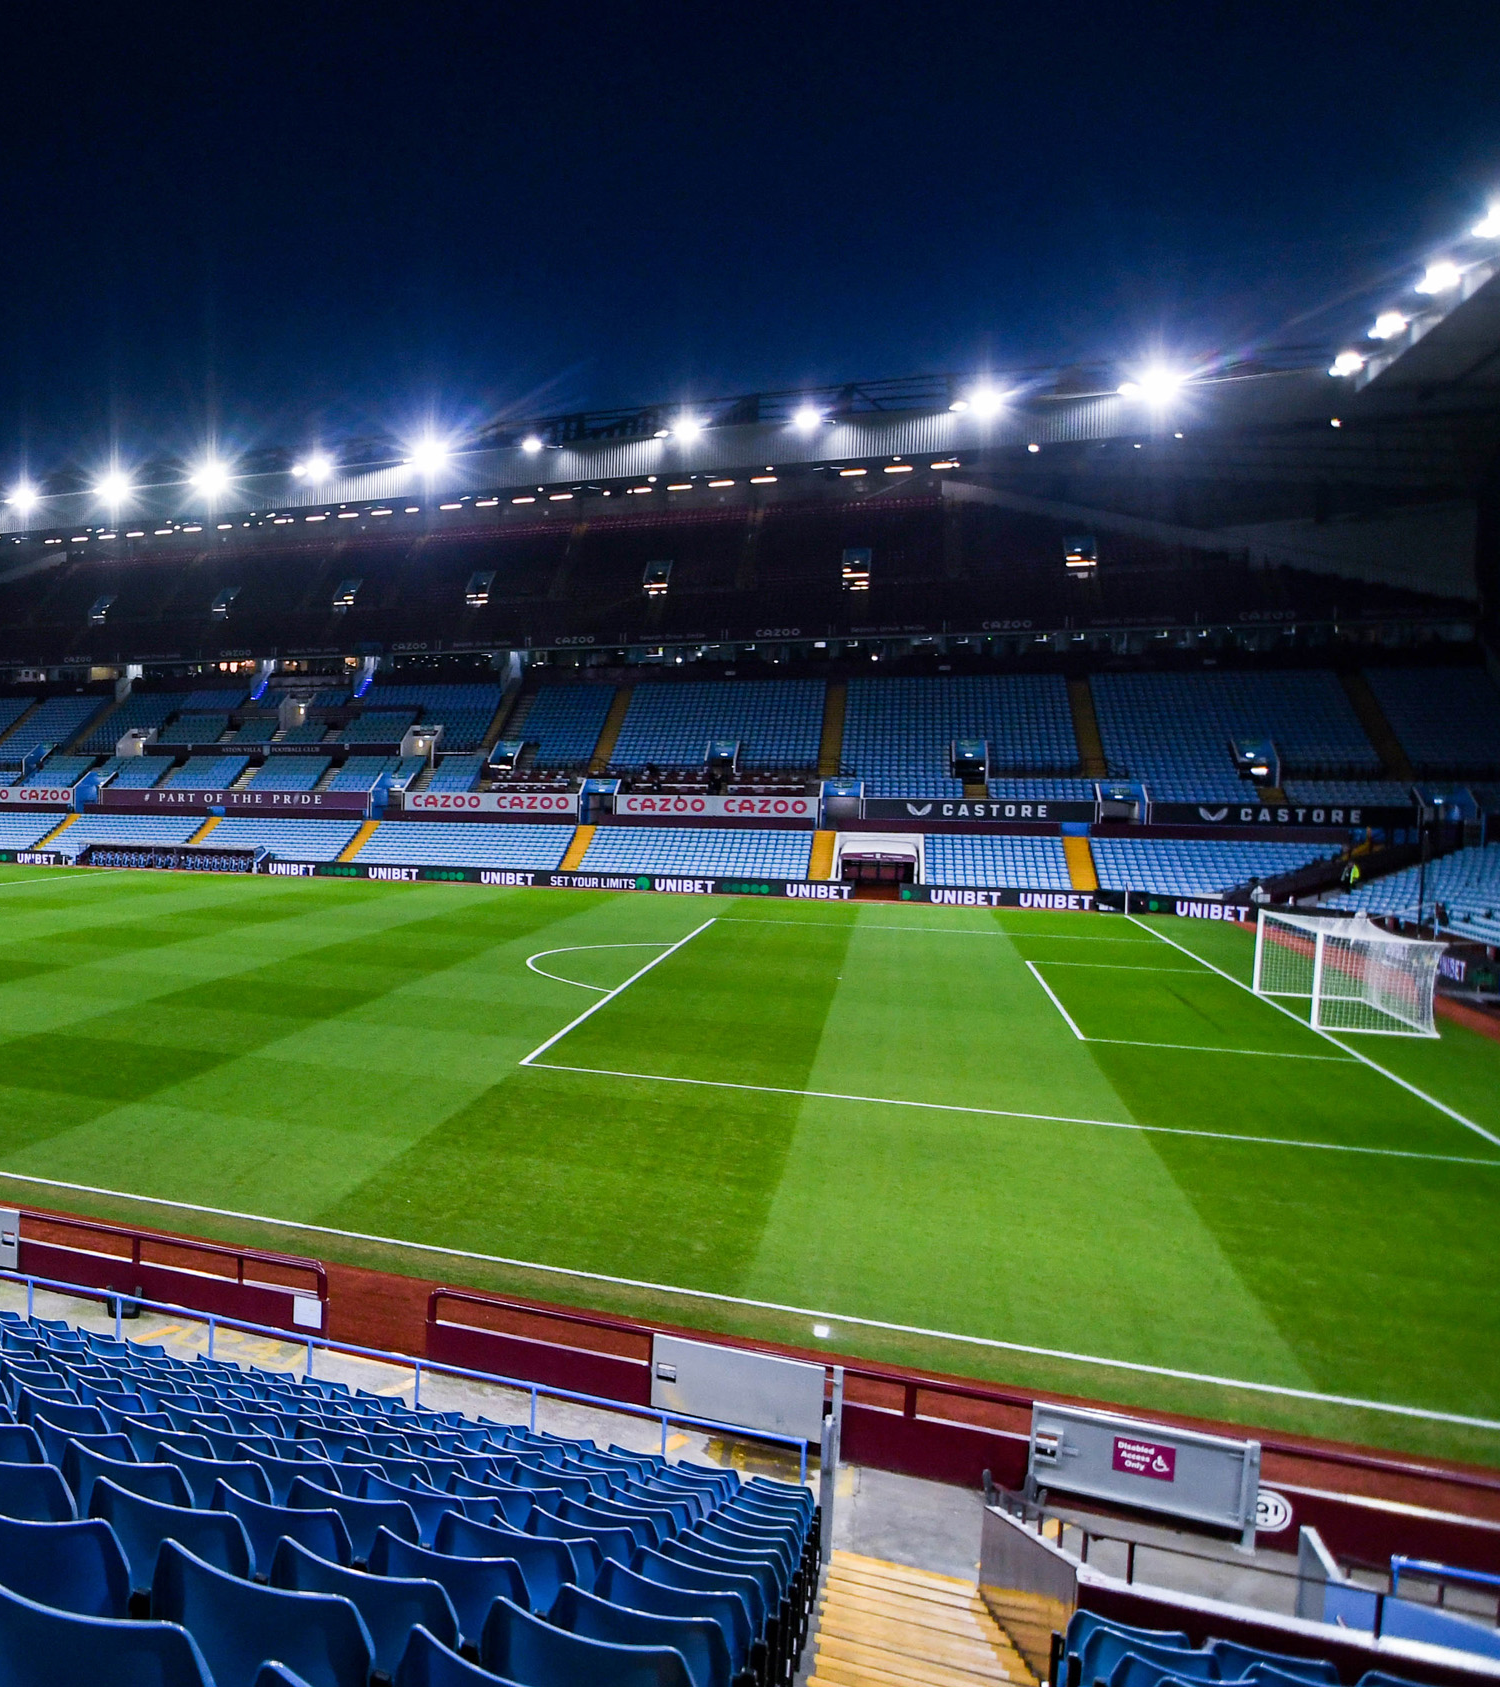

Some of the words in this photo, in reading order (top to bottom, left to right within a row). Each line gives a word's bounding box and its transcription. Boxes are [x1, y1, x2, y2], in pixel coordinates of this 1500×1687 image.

[981, 620, 1033, 630] CAZOO
[555, 635, 595, 645] CAZOO
[755, 628, 801, 638] CAZOO
[220, 649, 252, 657] CAZOO
[391, 642, 428, 651] CAZOO
[63, 656, 92, 664] CAZOO
[19, 789, 71, 801] CAZOO
[158, 793, 195, 803] PART
[203, 793, 223, 803] OF
[231, 794, 262, 804] THE
[412, 794, 481, 808] CAZOO
[496, 796, 569, 810] CAZOO
[626, 797, 706, 812] CAZOO
[723, 799, 807, 814] CAZOO
[942, 803, 1047, 818] CASTORE
[1240, 807, 1362, 824] CASTORE
[368, 866, 419, 881] UNIBET
[480, 871, 535, 886] UNIBET
[550, 875, 570, 887] SET
[571, 876, 599, 888] YOUR
[600, 877, 636, 890] LIMITS
[654, 878, 715, 894] UNIBET
[785, 883, 852, 899] UNIBET
[930, 889, 1001, 906] UNIBET
[1019, 892, 1094, 910] UNIBET
[1175, 900, 1250, 922] UNIBET
[1117, 1440, 1155, 1455] Disabled
[1120, 1450, 1150, 1463] Access
[1124, 1459, 1145, 1471] Only
[1256, 1502, 1279, 1517] Q1
